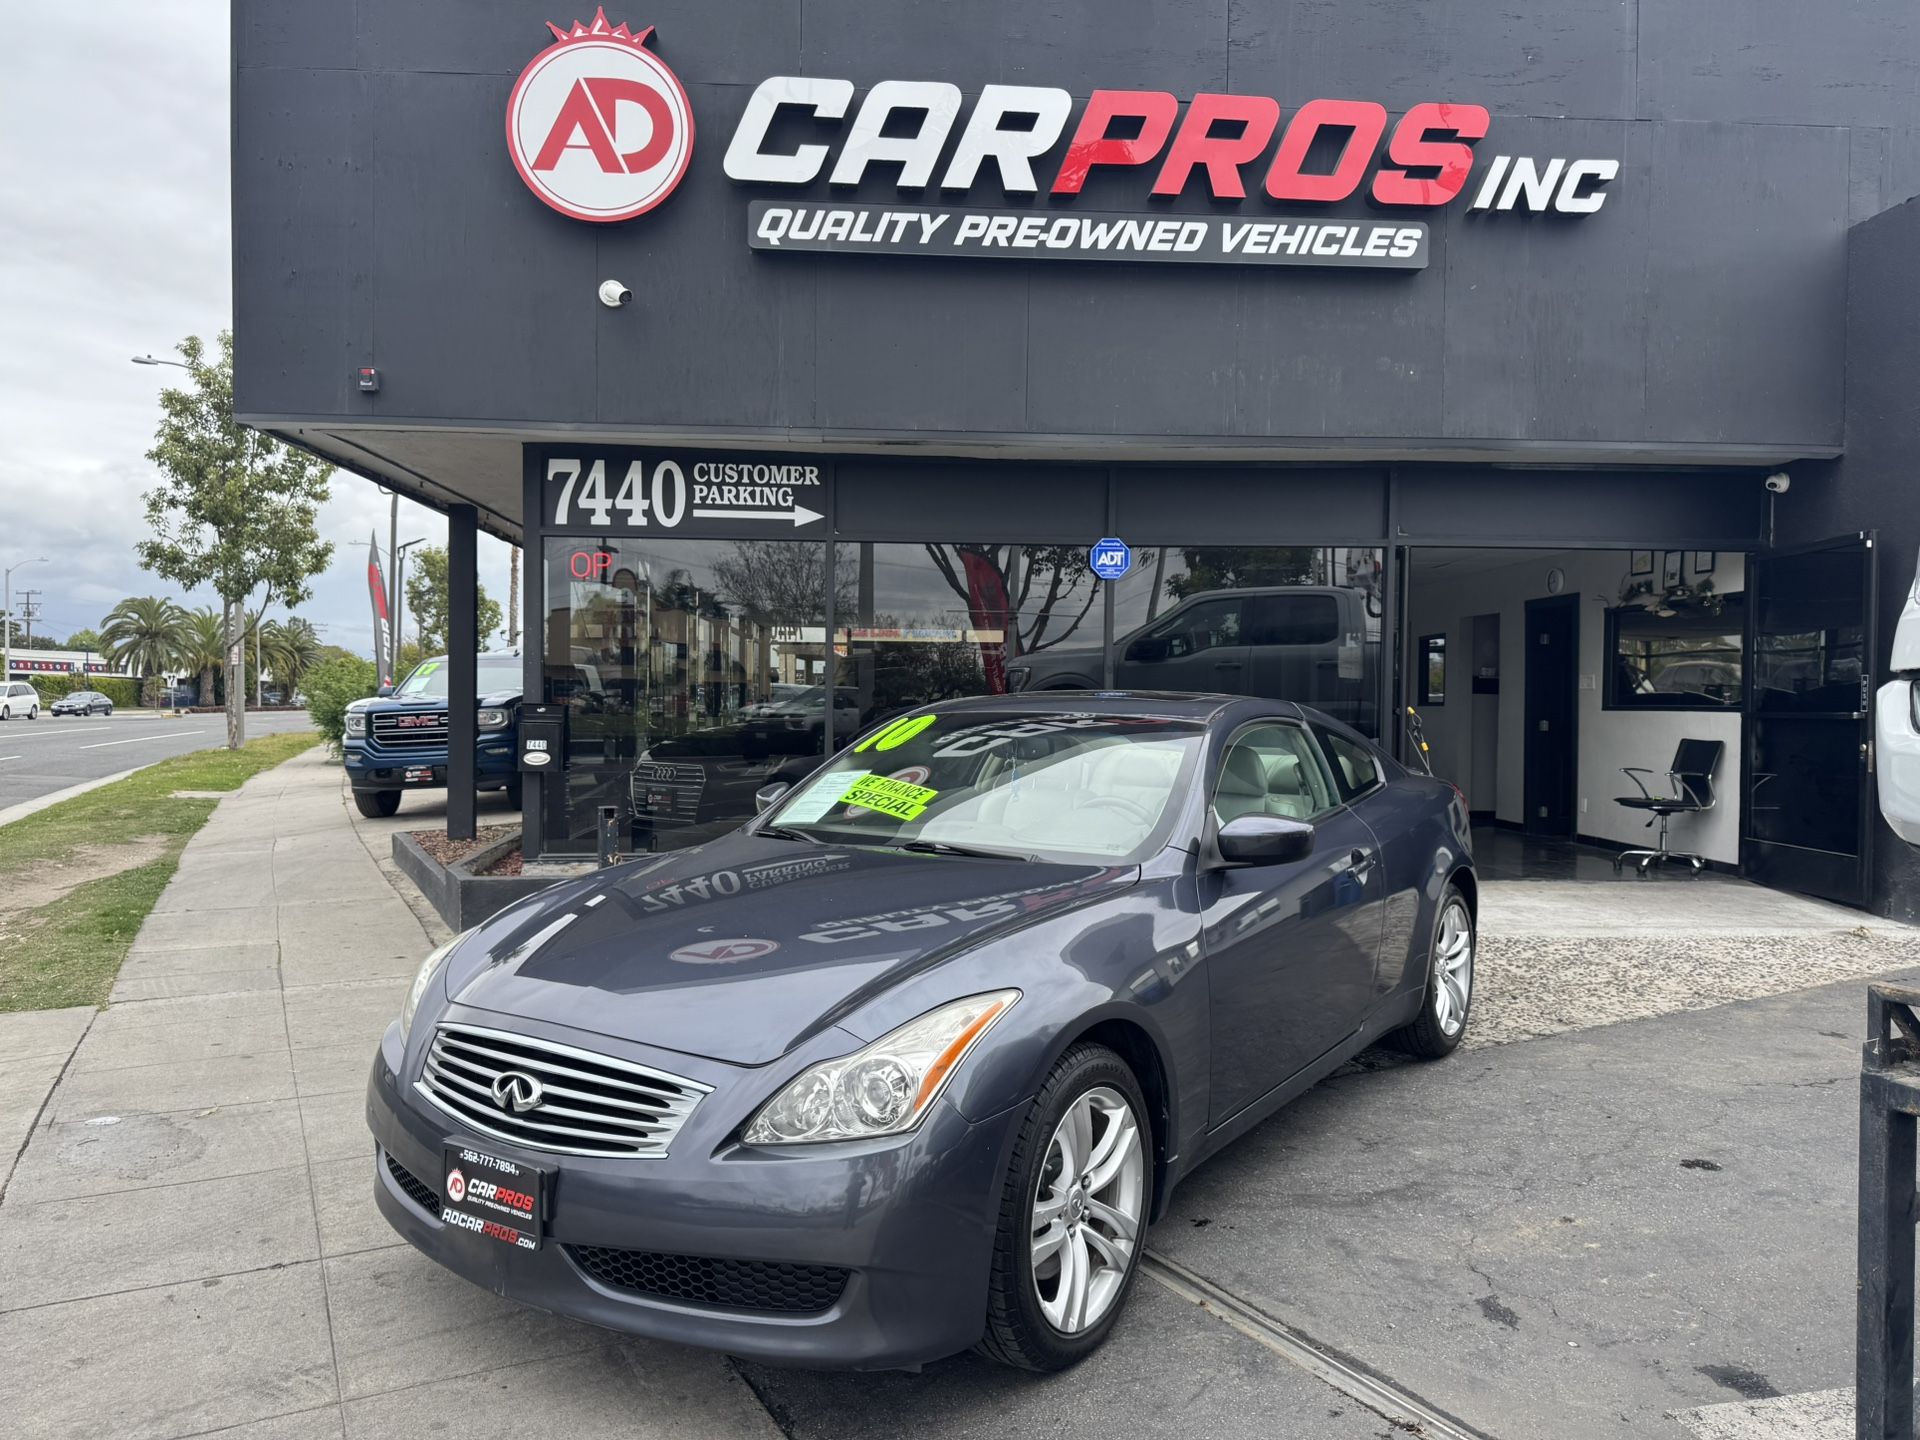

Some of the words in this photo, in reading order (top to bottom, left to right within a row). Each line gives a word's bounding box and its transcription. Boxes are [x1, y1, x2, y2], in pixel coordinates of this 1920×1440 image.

[531, 77, 675, 175] AD
[1473, 155, 1620, 213] INC
[756, 208, 950, 246] QUALITY
[953, 214, 1208, 252] PRE-OWNED
[1221, 222, 1423, 258] VEHICLES
[693, 462, 821, 486] CUSTOMER
[547, 458, 686, 528] 7440
[693, 484, 794, 507] PARKING
[1098, 551, 1125, 566] ADT
[11, 661, 75, 672] ontessori
[398, 714, 439, 727] GMC
[873, 779, 930, 800] FINANCE
[845, 789, 916, 816] SPECIAL
[463, 1149, 516, 1174] 562-777-7894
